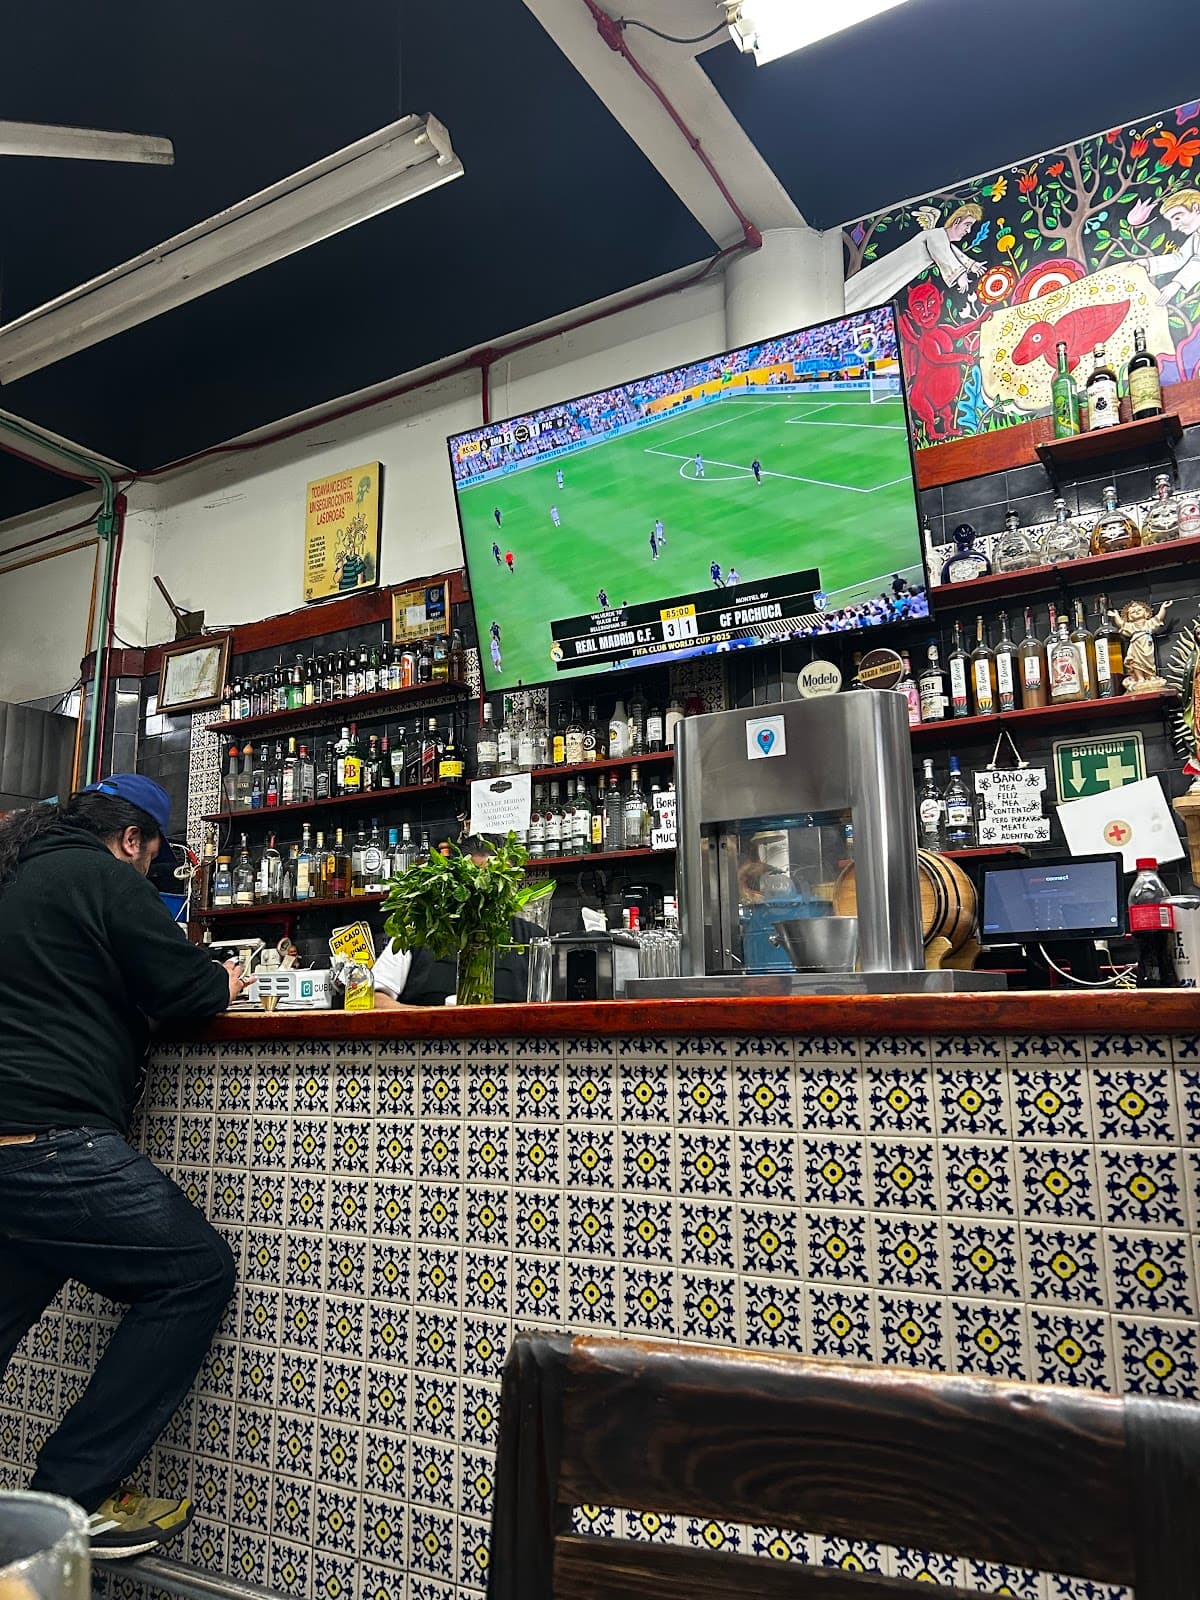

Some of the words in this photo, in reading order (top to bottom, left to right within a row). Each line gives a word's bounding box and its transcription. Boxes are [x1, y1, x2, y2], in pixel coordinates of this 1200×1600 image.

[668, 404, 688, 416] BETTER
[462, 444, 478, 455] 85:00
[541, 420, 553, 431] PAC
[535, 448, 560, 462] INVESTED
[567, 440, 587, 453] BETTER
[465, 474, 485, 485] BETTER
[334, 490, 354, 507] CONTRA
[325, 506, 345, 523] DROGAS
[666, 607, 689, 618] 85:00
[575, 641, 598, 655] REAL
[600, 631, 634, 650] MADRID
[637, 628, 656, 644] C.F.
[668, 623, 675, 637] 3
[685, 619, 692, 634] 1
[719, 612, 732, 628] CF
[734, 603, 783, 624] PACHUCA
[632, 648, 648, 657] FIFA
[648, 641, 667, 654] CLUB
[668, 637, 695, 651] WORLD
[695, 634, 711, 645] CUP
[711, 632, 731, 642] 2025
[861, 667, 879, 679] NEGRA
[879, 661, 900, 675] MODELO
[802, 672, 838, 688] Modelo
[1072, 742, 1124, 758] BOTIQUIN
[477, 801, 494, 809] VENTA
[504, 798, 525, 806] BEBIDAS
[993, 806, 1031, 815] CONTENTO
[1001, 823, 1028, 831] MEATE
[334, 940, 344, 949] EN
[343, 928, 360, 943] CASO
